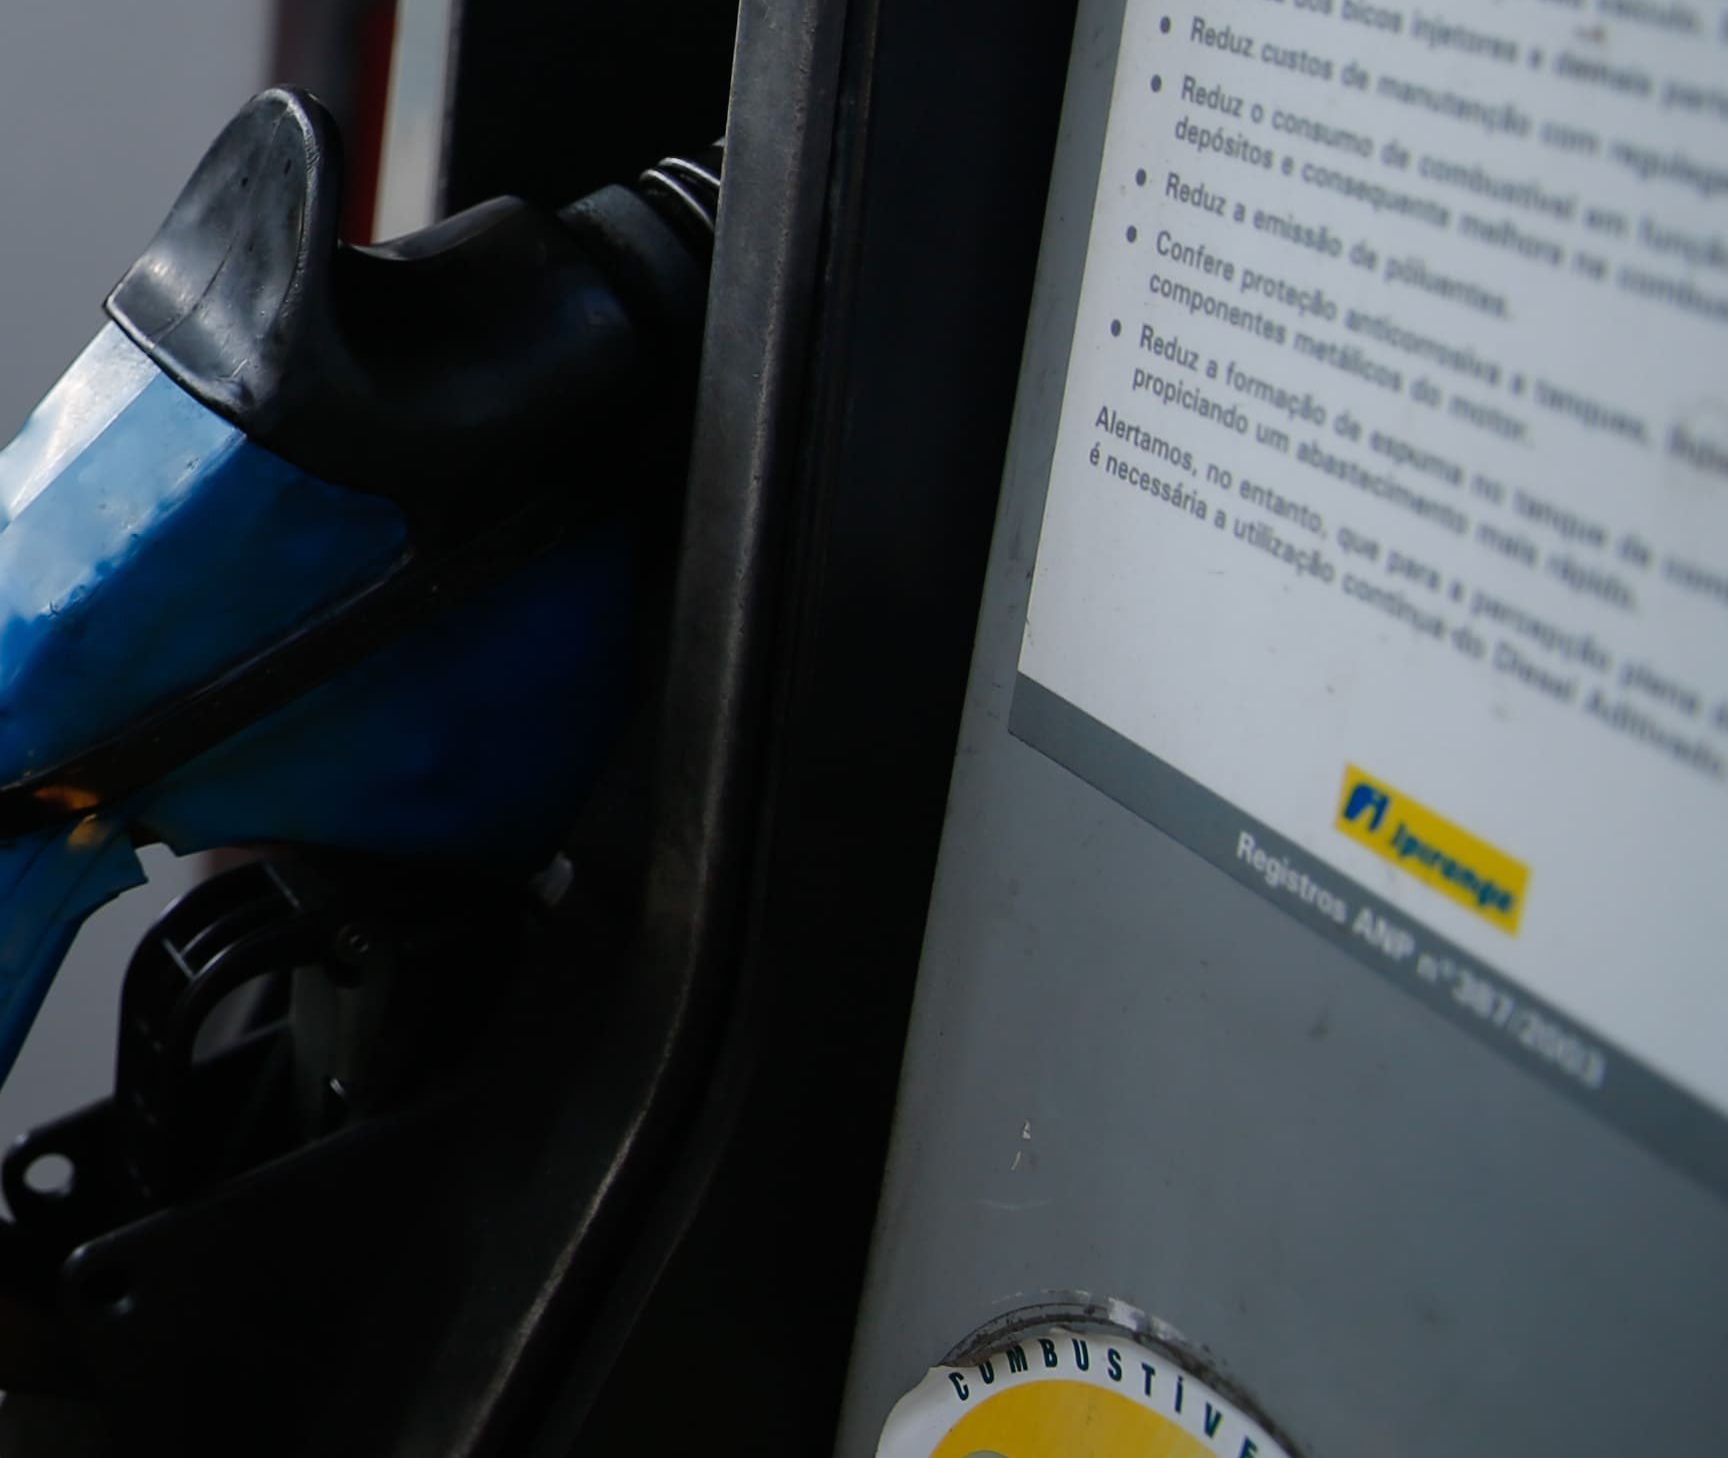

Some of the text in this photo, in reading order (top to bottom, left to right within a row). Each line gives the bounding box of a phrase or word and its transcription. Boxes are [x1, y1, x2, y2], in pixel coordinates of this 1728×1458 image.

[1190, 16, 1255, 58] Reduz
[1261, 42, 1333, 81] custos
[1341, 58, 1370, 91] de
[1175, 116, 1275, 169] depósitos
[1281, 155, 1295, 177] e
[1181, 75, 1245, 118] Reduz
[1251, 103, 1265, 124] o
[1272, 109, 1374, 159] consumo
[1381, 140, 1410, 171] de
[1156, 230, 1235, 282] Confere
[1241, 267, 1338, 322] proteção
[1165, 171, 1227, 217] Reduz
[1233, 202, 1246, 224] a
[1253, 210, 1343, 258] emissão
[1349, 239, 1378, 272] de
[1149, 273, 1287, 345] componentes
[1294, 330, 1402, 393] metálicos
[1132, 368, 1249, 434] propiciando
[1255, 423, 1290, 453] um
[1297, 438, 1469, 535] abastecimento
[1139, 324, 1199, 372] Reduz
[1205, 358, 1218, 380] a
[1226, 361, 1327, 421] formação
[1333, 409, 1362, 442] de
[1369, 428, 1463, 486] espuma
[1089, 441, 1100, 467] é
[1105, 453, 1208, 521] necessária
[1214, 508, 1227, 530] a
[1234, 516, 1335, 584] utilização
[1095, 405, 1198, 478] Alertamos,
[1205, 462, 1233, 491] no
[1239, 479, 1328, 541] entanto,
[1337, 526, 1382, 561] que
[1386, 549, 1442, 591] para
[1236, 830, 1349, 923] Registros
[1352, 906, 1416, 962] ANP
